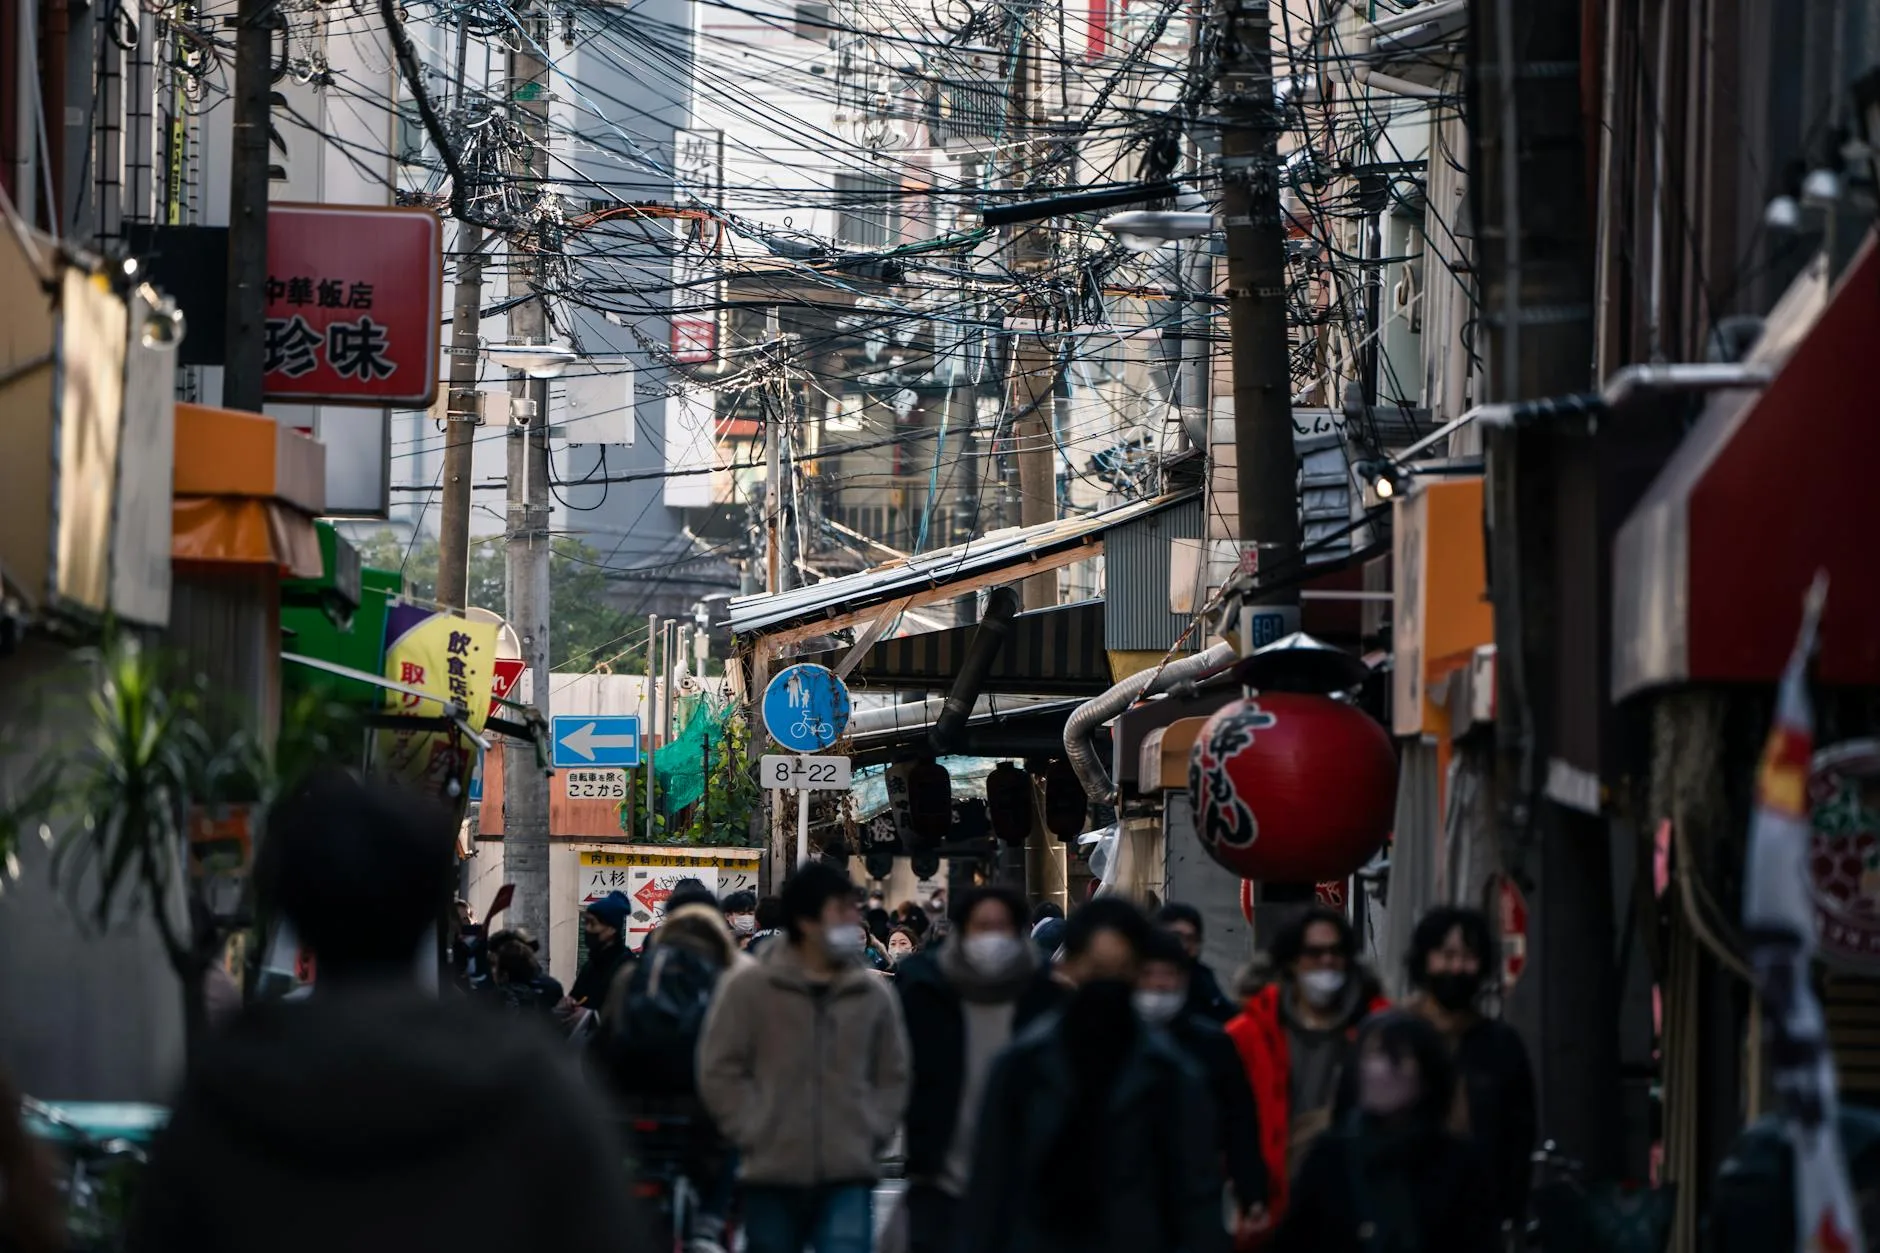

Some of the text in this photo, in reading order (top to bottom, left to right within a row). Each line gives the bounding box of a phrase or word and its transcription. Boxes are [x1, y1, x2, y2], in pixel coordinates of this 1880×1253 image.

[265, 275, 374, 310] 中華飯店
[264, 314, 399, 383] 珍味
[569, 772, 624, 783] 自転車を除く
[775, 762, 837, 783] 8-22
[569, 784, 625, 798] ここから
